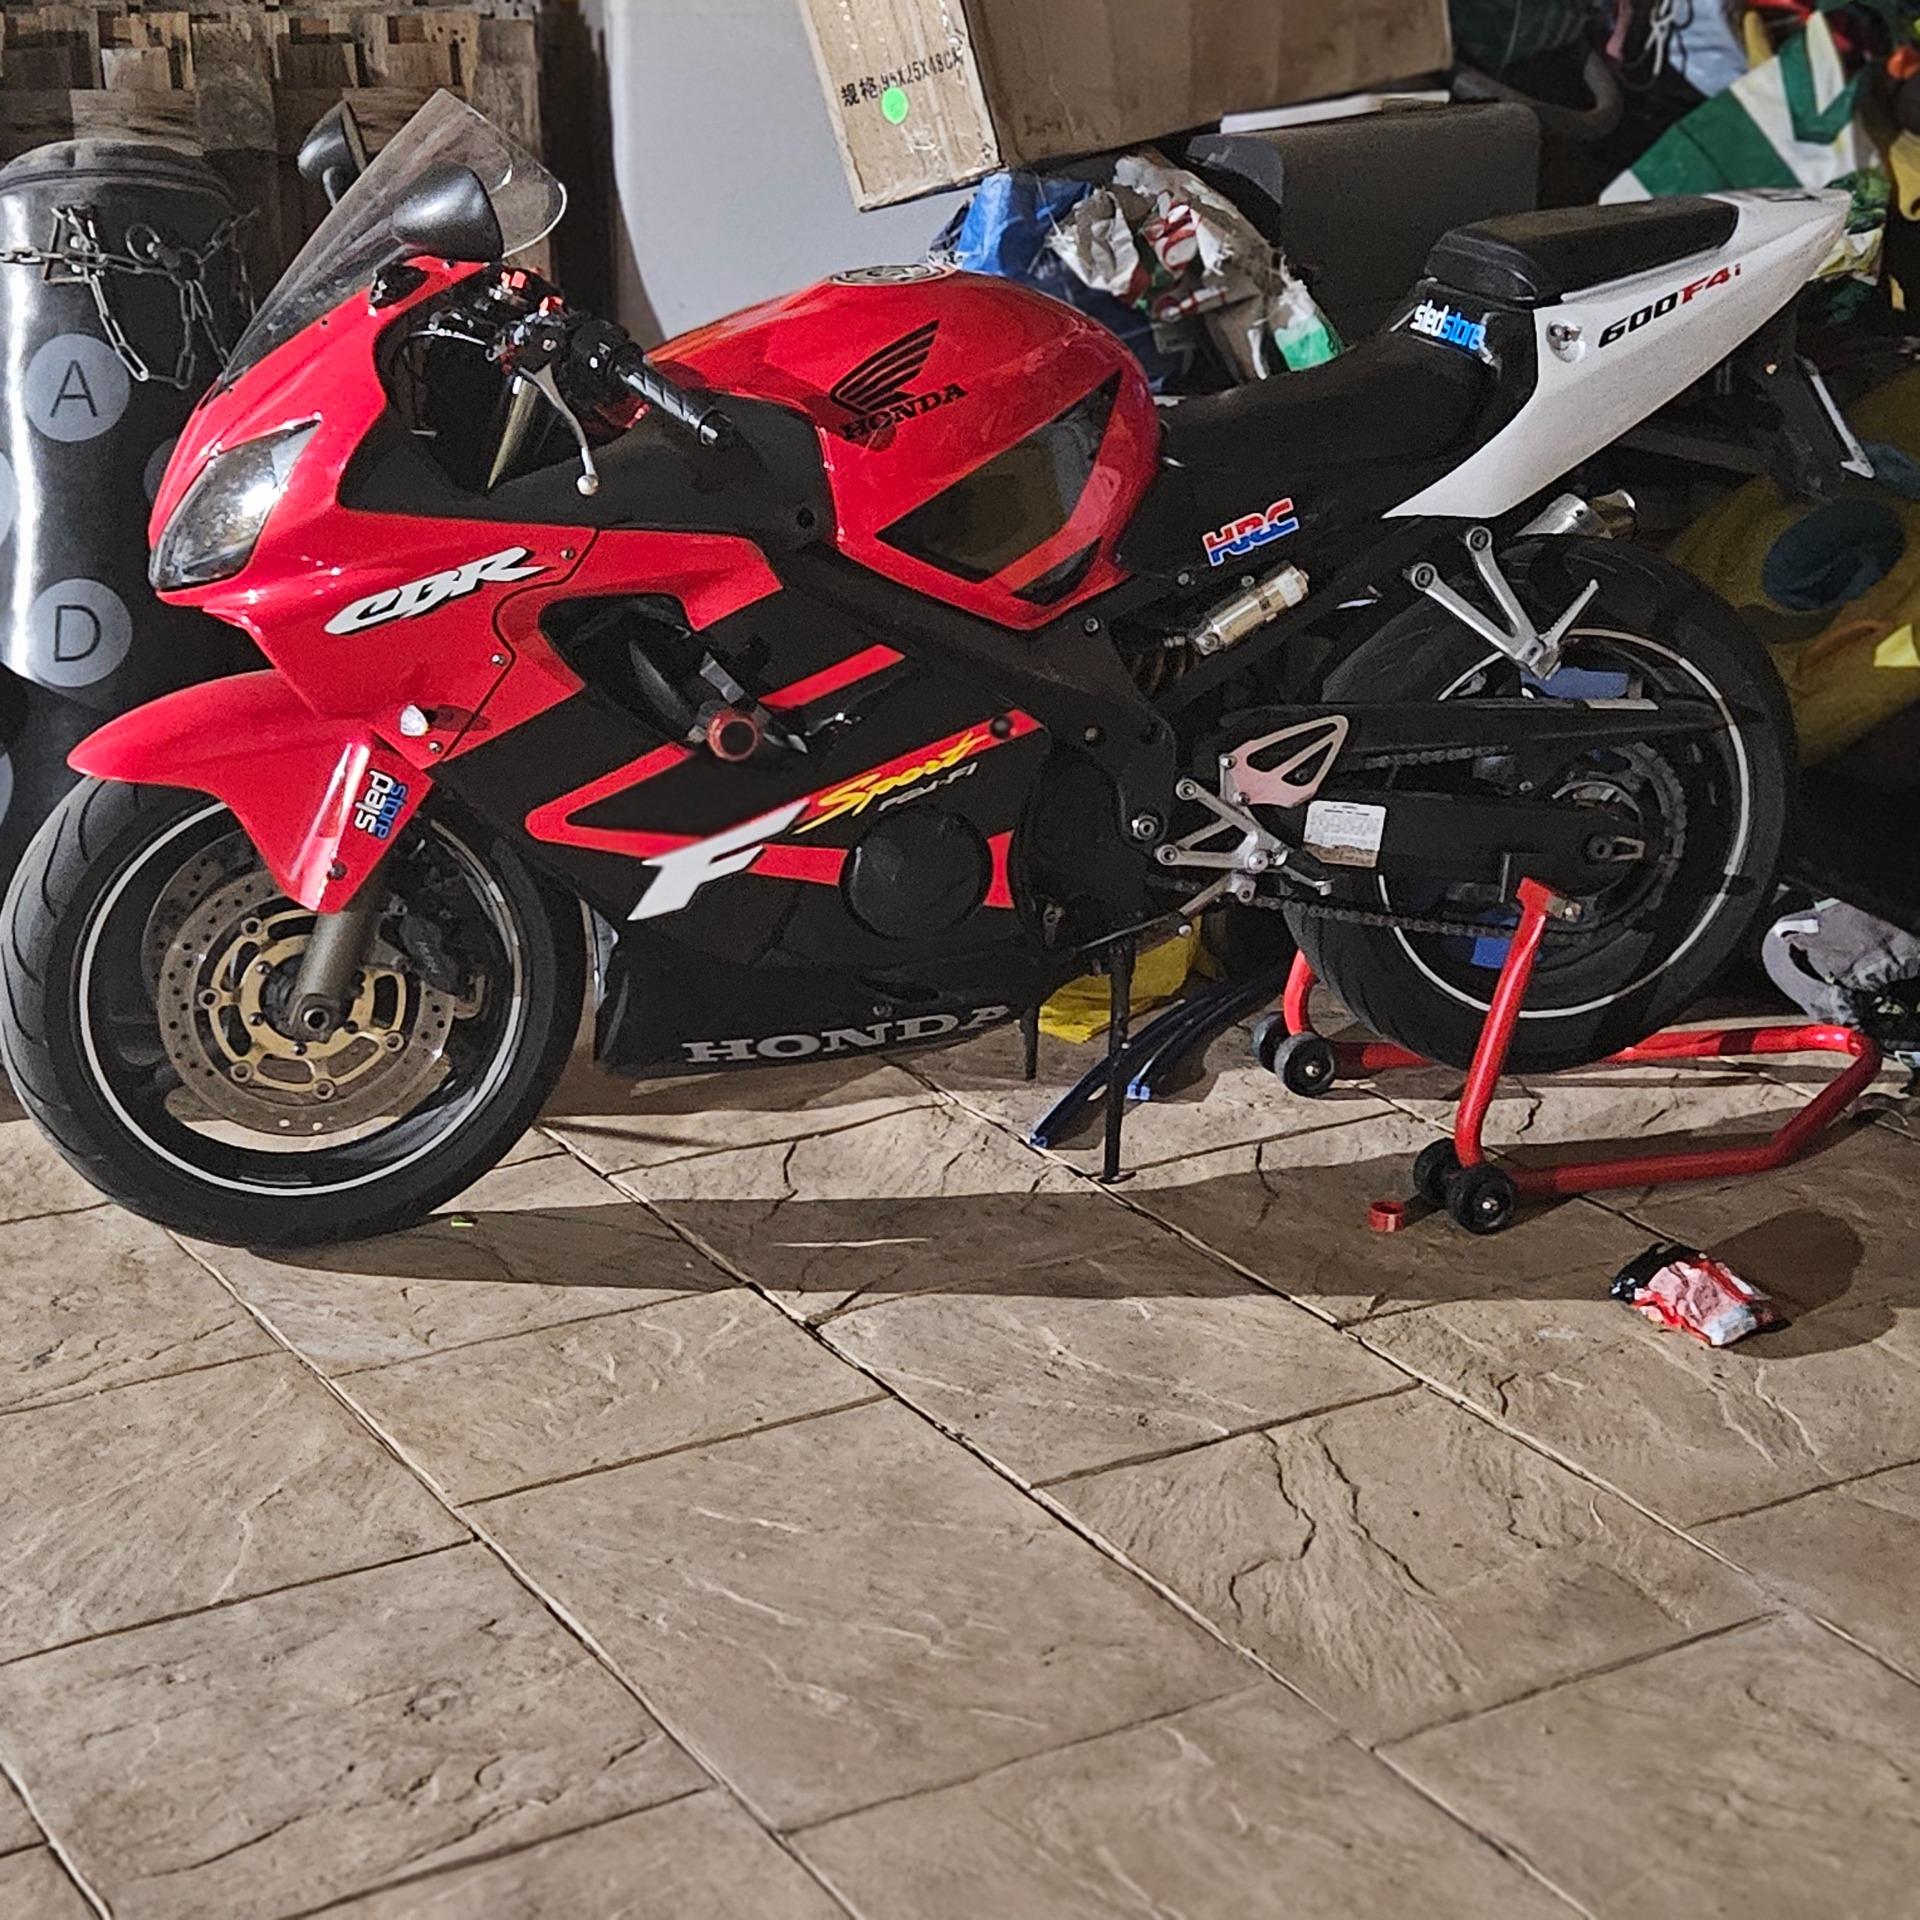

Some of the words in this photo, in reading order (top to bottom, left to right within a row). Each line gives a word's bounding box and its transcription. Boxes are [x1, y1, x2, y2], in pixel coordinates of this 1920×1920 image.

[1598, 263, 1741, 348] 600F4i
[50, 359, 98, 418] A
[840, 383, 968, 440] HONDA
[1202, 498, 1299, 567] HRC
[324, 546, 550, 635] CBR
[54, 604, 101, 662] D
[354, 769, 396, 834] sled
[792, 731, 990, 835] Sport
[682, 1005, 1010, 1062] HONDA
